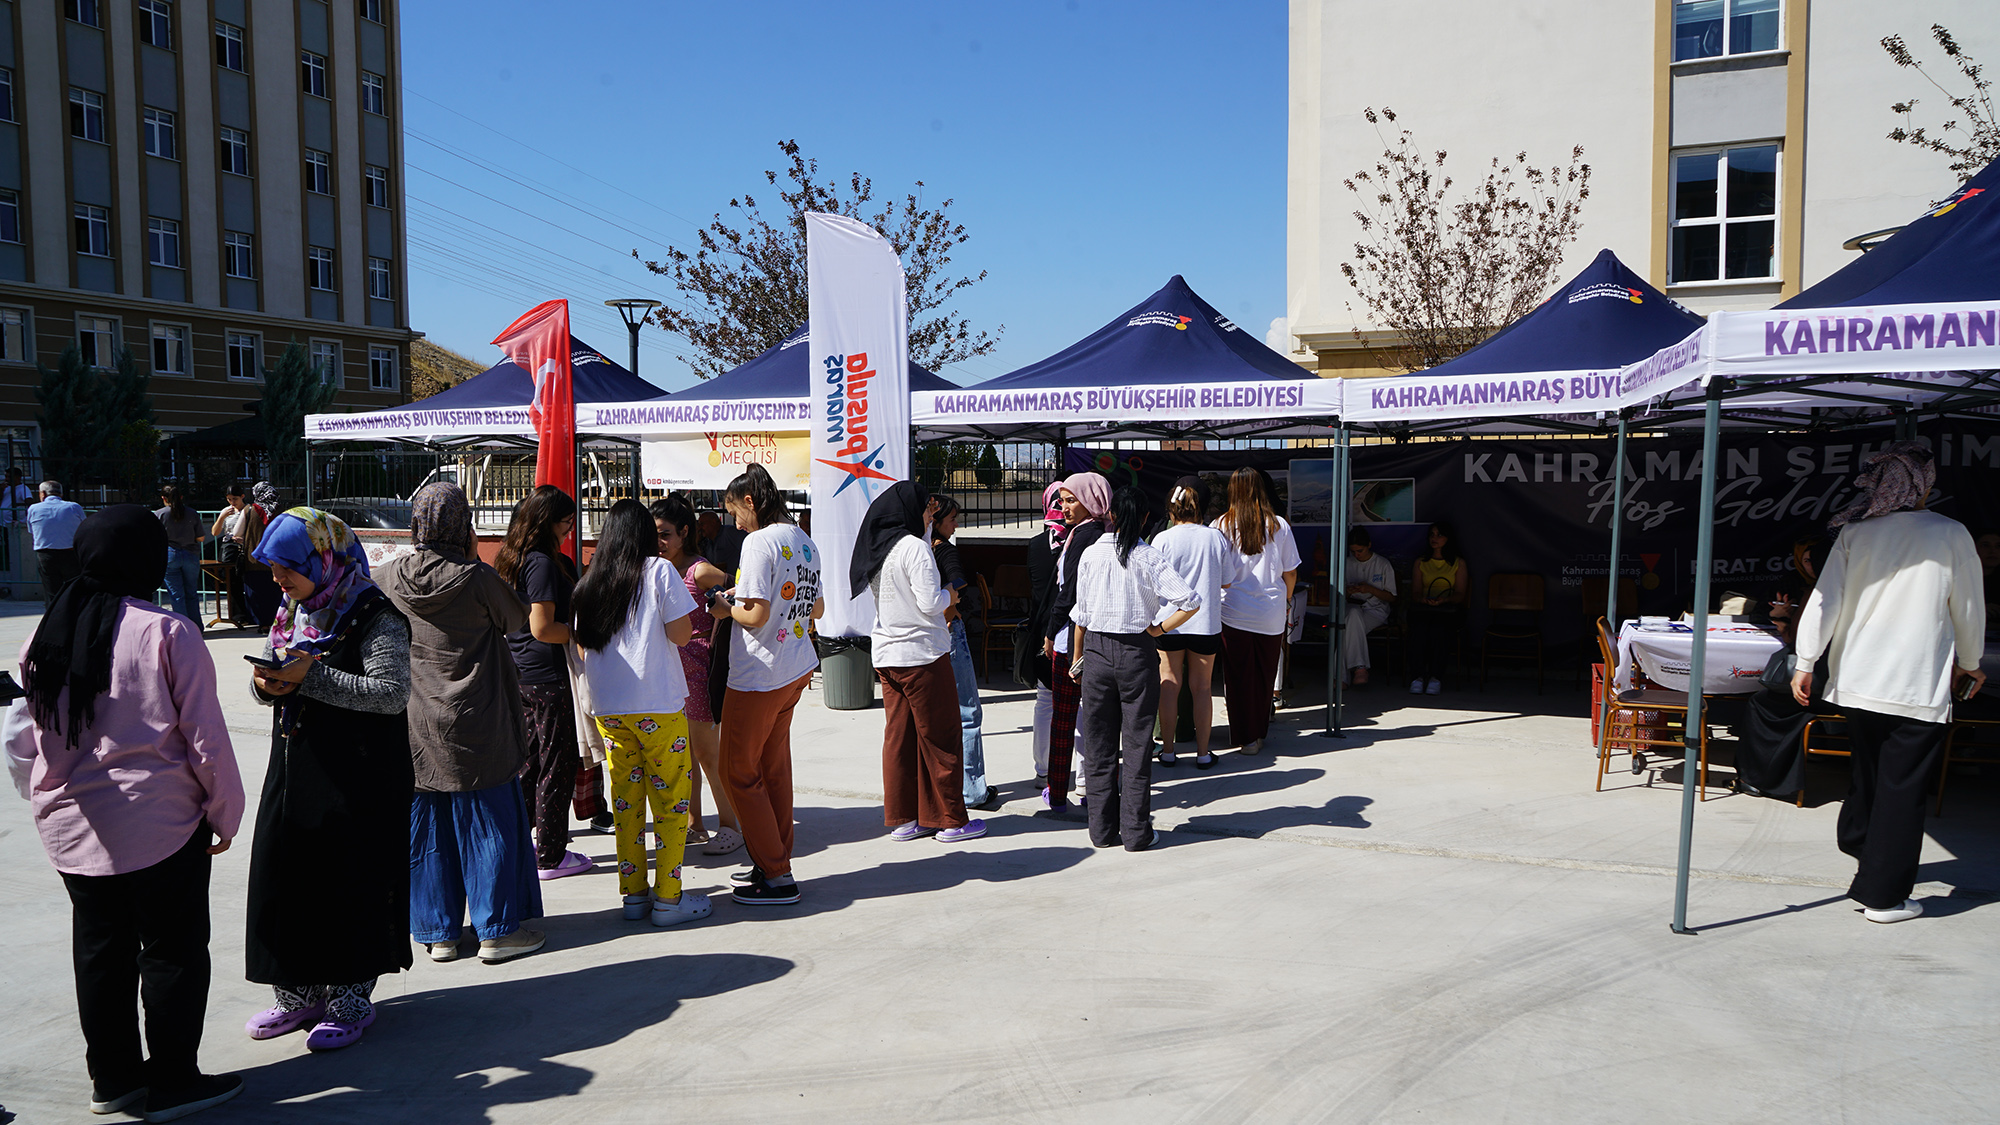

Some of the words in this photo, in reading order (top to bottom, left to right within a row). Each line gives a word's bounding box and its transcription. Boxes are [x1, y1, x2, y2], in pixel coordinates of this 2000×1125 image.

[1765, 309, 2000, 356] KAHRAMAN
[934, 391, 1083, 413] KAHRAMANMARAŞ
[1087, 386, 1196, 412] BÜYÜKŞEHİR
[1200, 383, 1304, 408] BELEDİYESİ
[1372, 378, 1565, 409] KAHRAMANMARAŞ
[318, 413, 411, 432] KAHRAMANMARAŞ
[596, 405, 709, 425] KAHRAMANMARAŞ
[712, 401, 796, 423] BÜYÜKŞEHİR
[721, 431, 777, 452] GENÇLİK
[721, 448, 777, 465] MECLİSİ
[1464, 446, 1759, 483] KAHRAMAN
[1586, 476, 1685, 531] Hoş
[1562, 565, 1641, 577] Kahramanaraş
